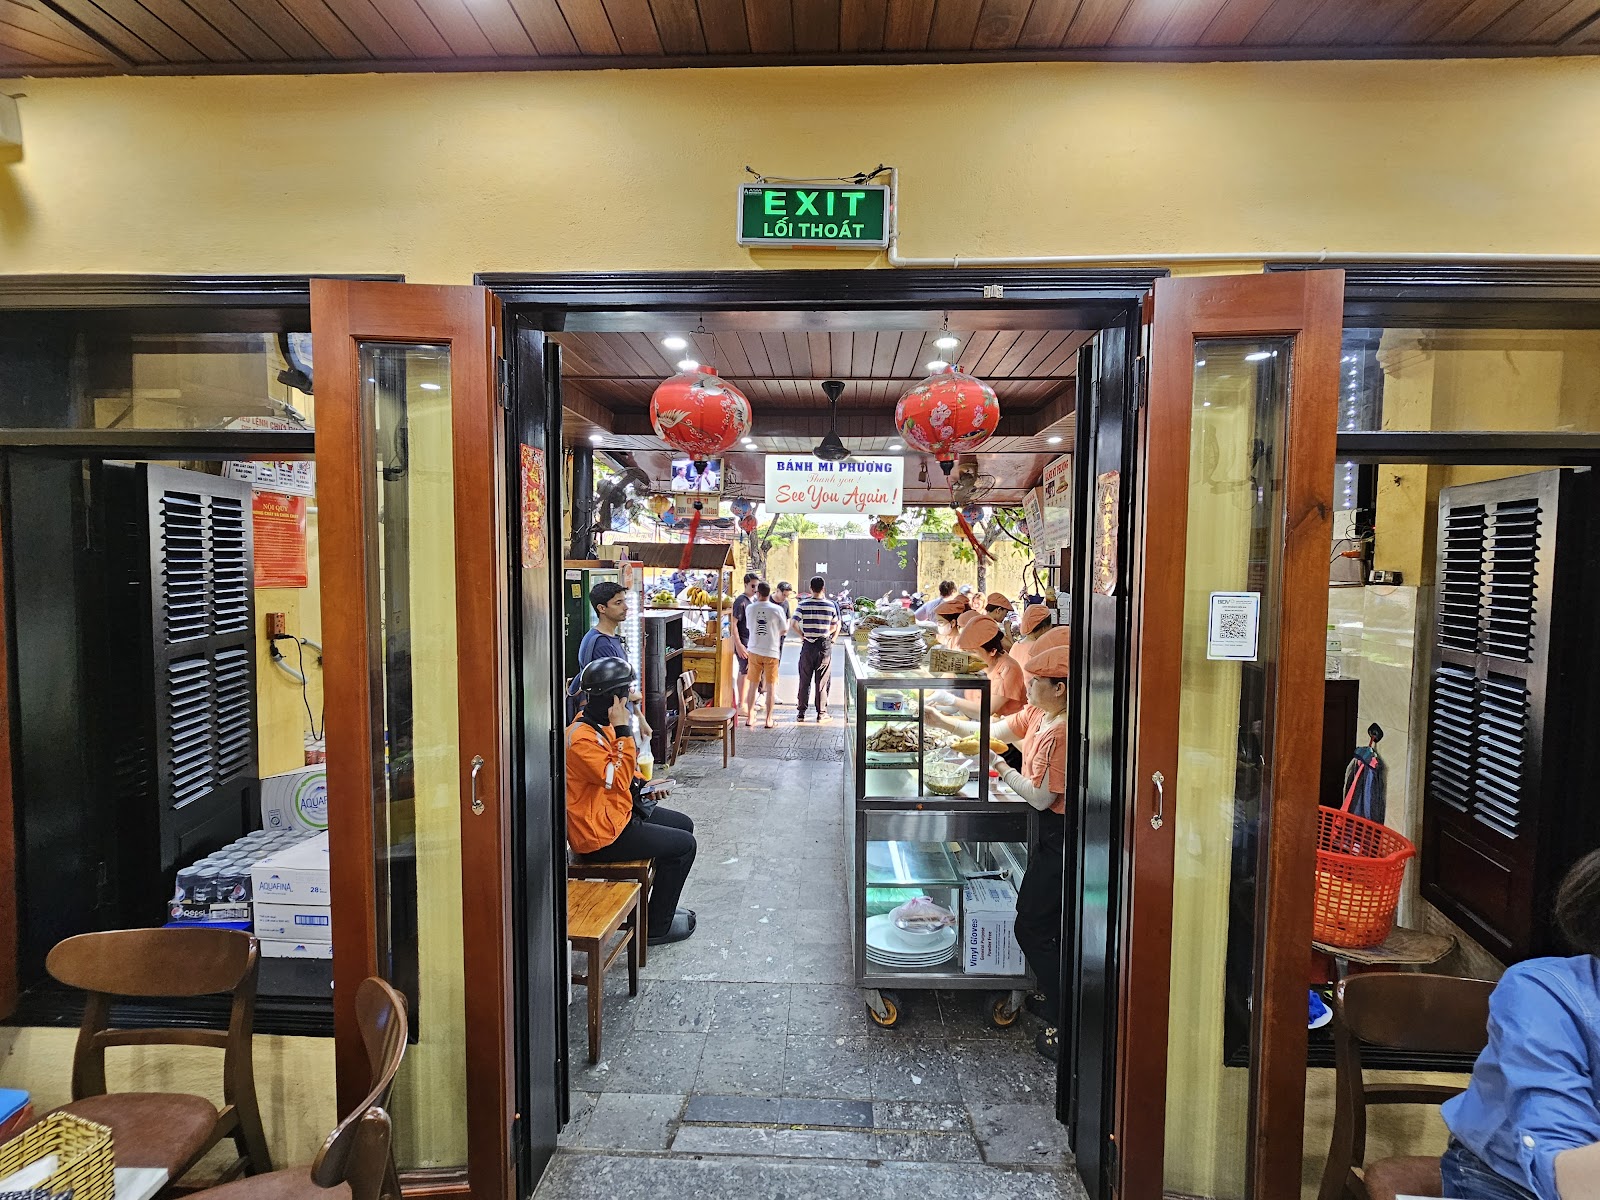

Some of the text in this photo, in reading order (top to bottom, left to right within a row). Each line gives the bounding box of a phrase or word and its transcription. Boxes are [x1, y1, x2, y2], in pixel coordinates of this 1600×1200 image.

[765, 190, 866, 216] EXIT
[764, 217, 865, 238] LỐI THOÁT
[777, 459, 813, 472] BÁNH
[838, 460, 893, 475] PHƯỢNG
[806, 472, 836, 484] Thank
[838, 477, 854, 487] you
[775, 484, 806, 503] See
[807, 484, 839, 510] You
[842, 486, 889, 513] Again
[300, 796, 327, 810] AQUAF
[258, 881, 293, 892] AQUAFINA
[970, 947, 979, 967] Vinyl
